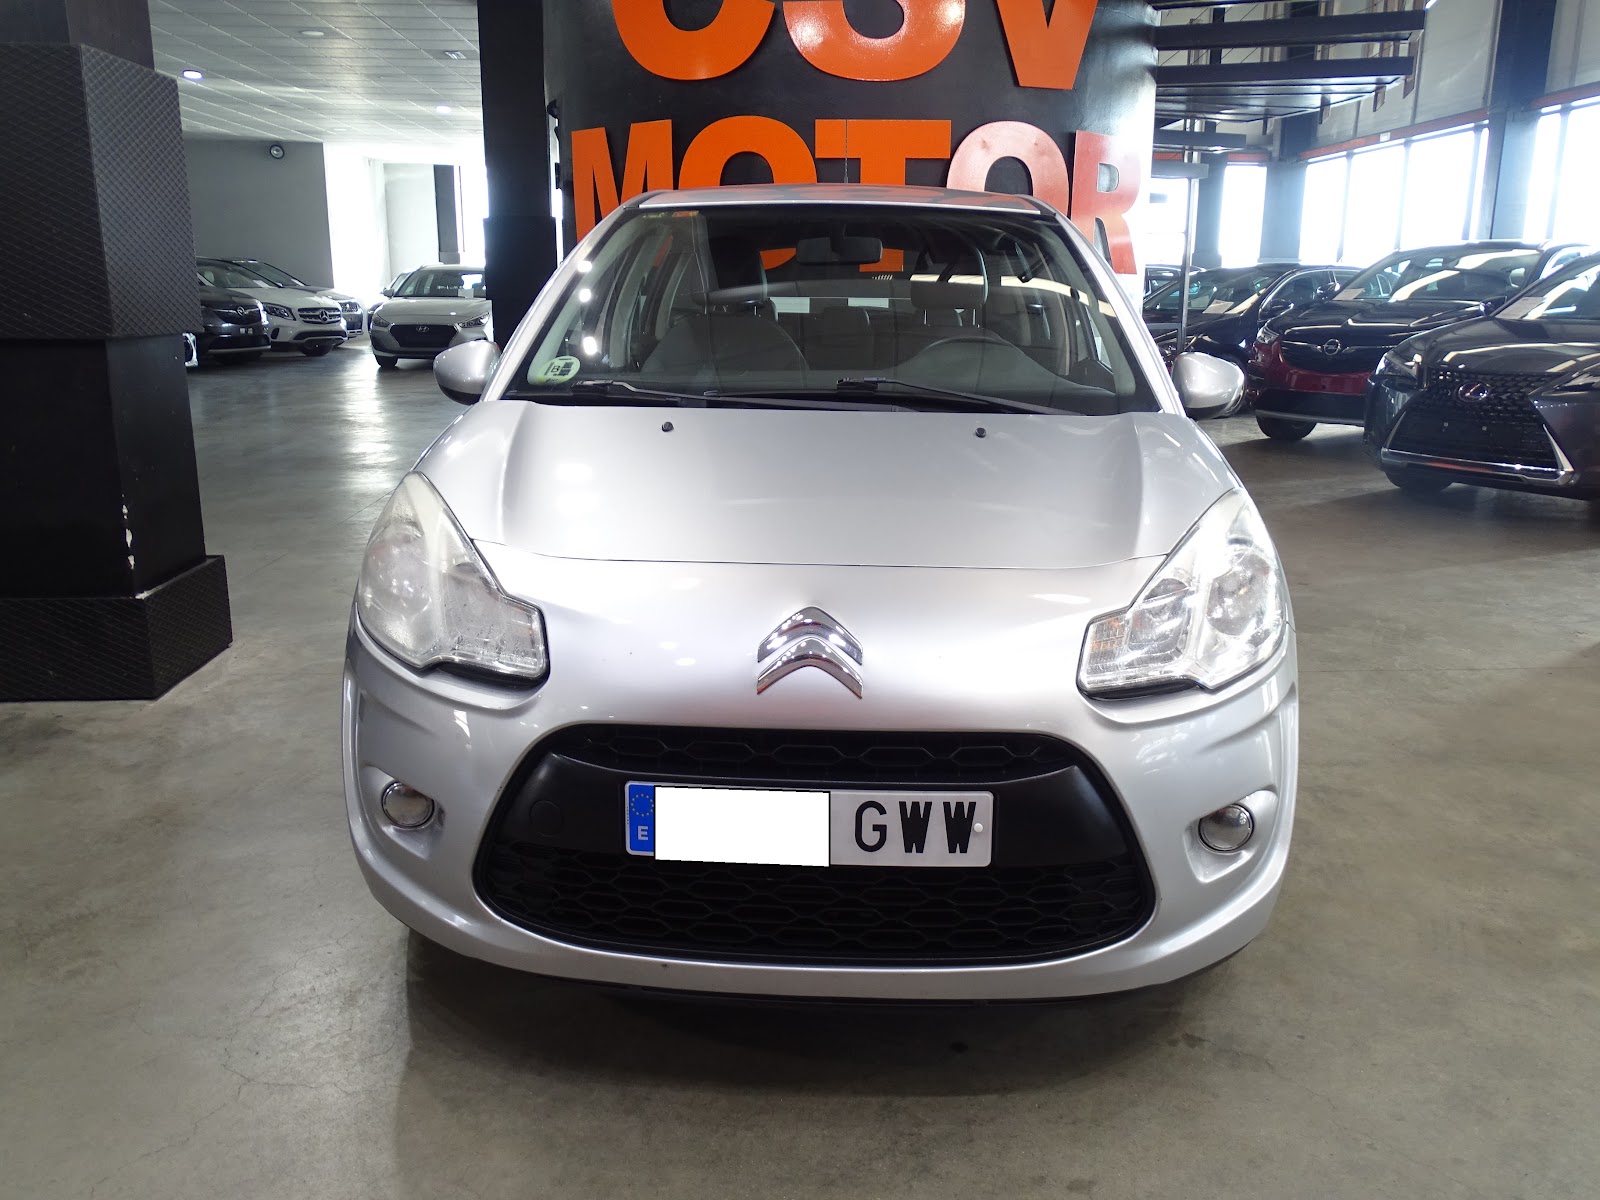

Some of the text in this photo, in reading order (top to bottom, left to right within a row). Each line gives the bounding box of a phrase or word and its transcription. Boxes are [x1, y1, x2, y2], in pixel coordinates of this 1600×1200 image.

[571, 115, 1141, 274] MOTOR
[637, 825, 649, 841] E
[854, 800, 977, 854] GWW
